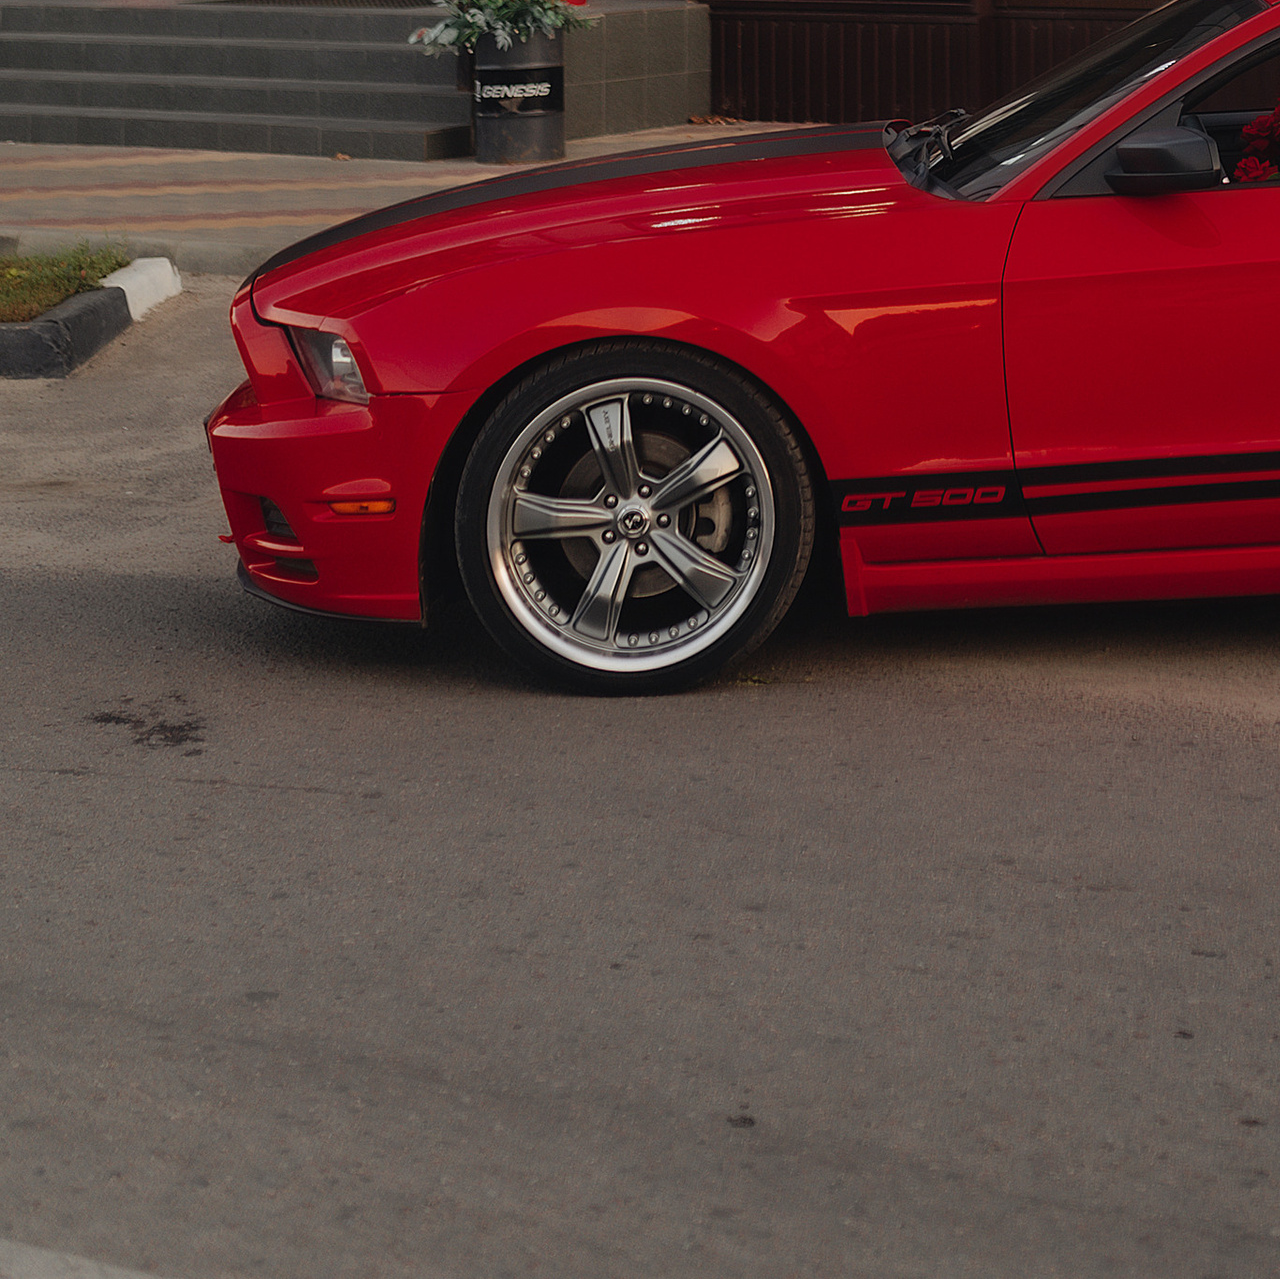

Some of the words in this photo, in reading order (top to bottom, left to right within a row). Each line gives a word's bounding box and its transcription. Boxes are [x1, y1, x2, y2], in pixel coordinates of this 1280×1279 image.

[481, 82, 551, 98] GENESIS
[841, 492, 906, 512] GT
[911, 486, 1006, 508] 500
